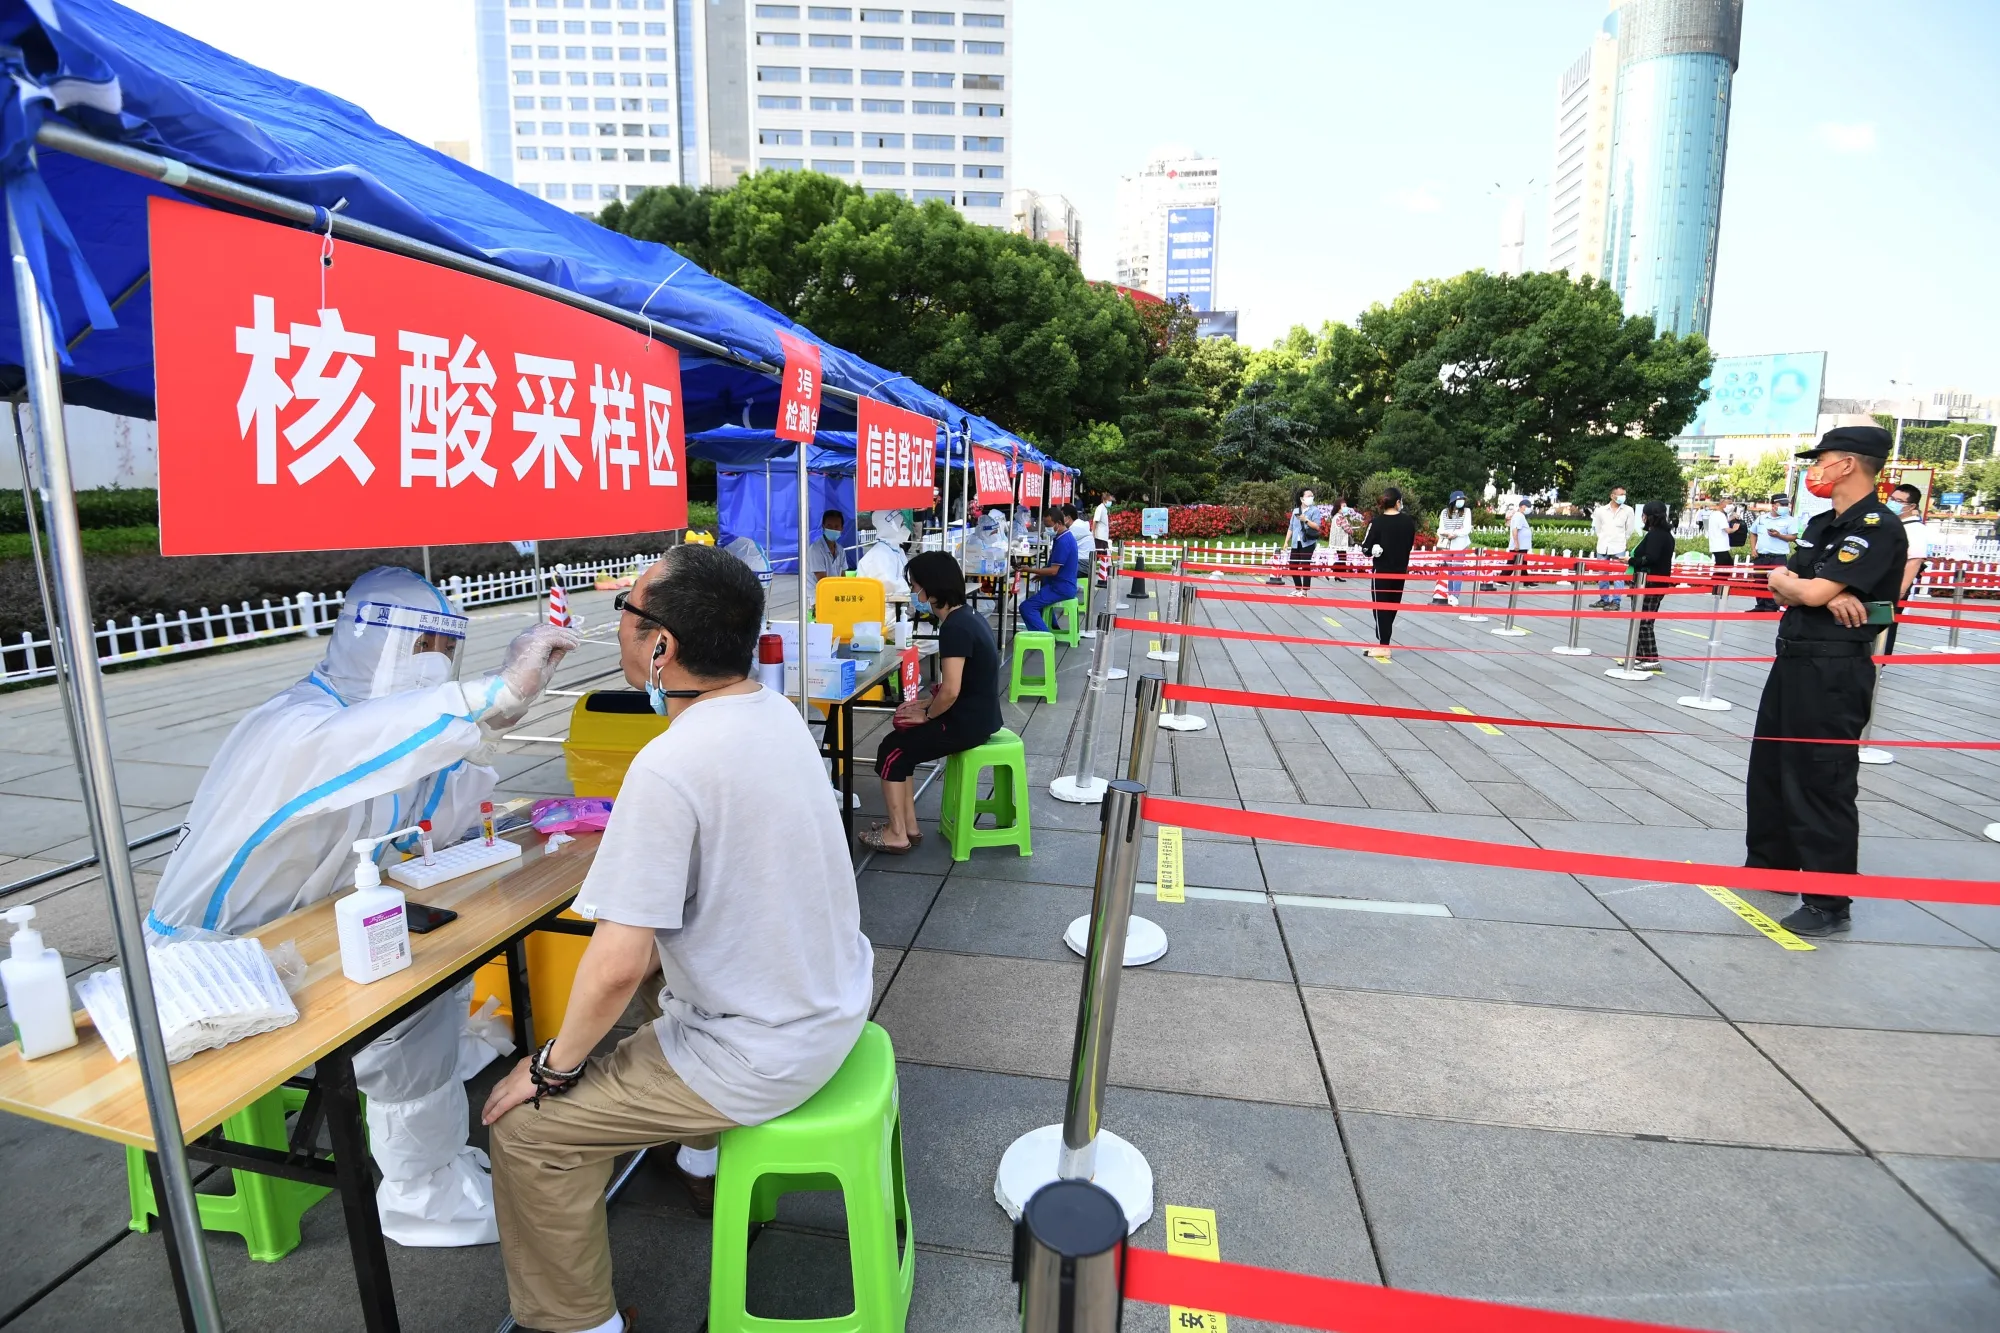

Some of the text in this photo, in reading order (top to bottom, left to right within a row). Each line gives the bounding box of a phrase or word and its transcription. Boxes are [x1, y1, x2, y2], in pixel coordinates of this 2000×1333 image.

[235, 294, 678, 490] 核酸采样区
[797, 368, 813, 399] 3号
[785, 399, 818, 436] 检测台
[866, 423, 933, 489] 信息登记区
[978, 457, 1012, 493] 核酸采样区
[1179, 1312, 1204, 1329] 安
[1207, 1313, 1217, 1323] of
